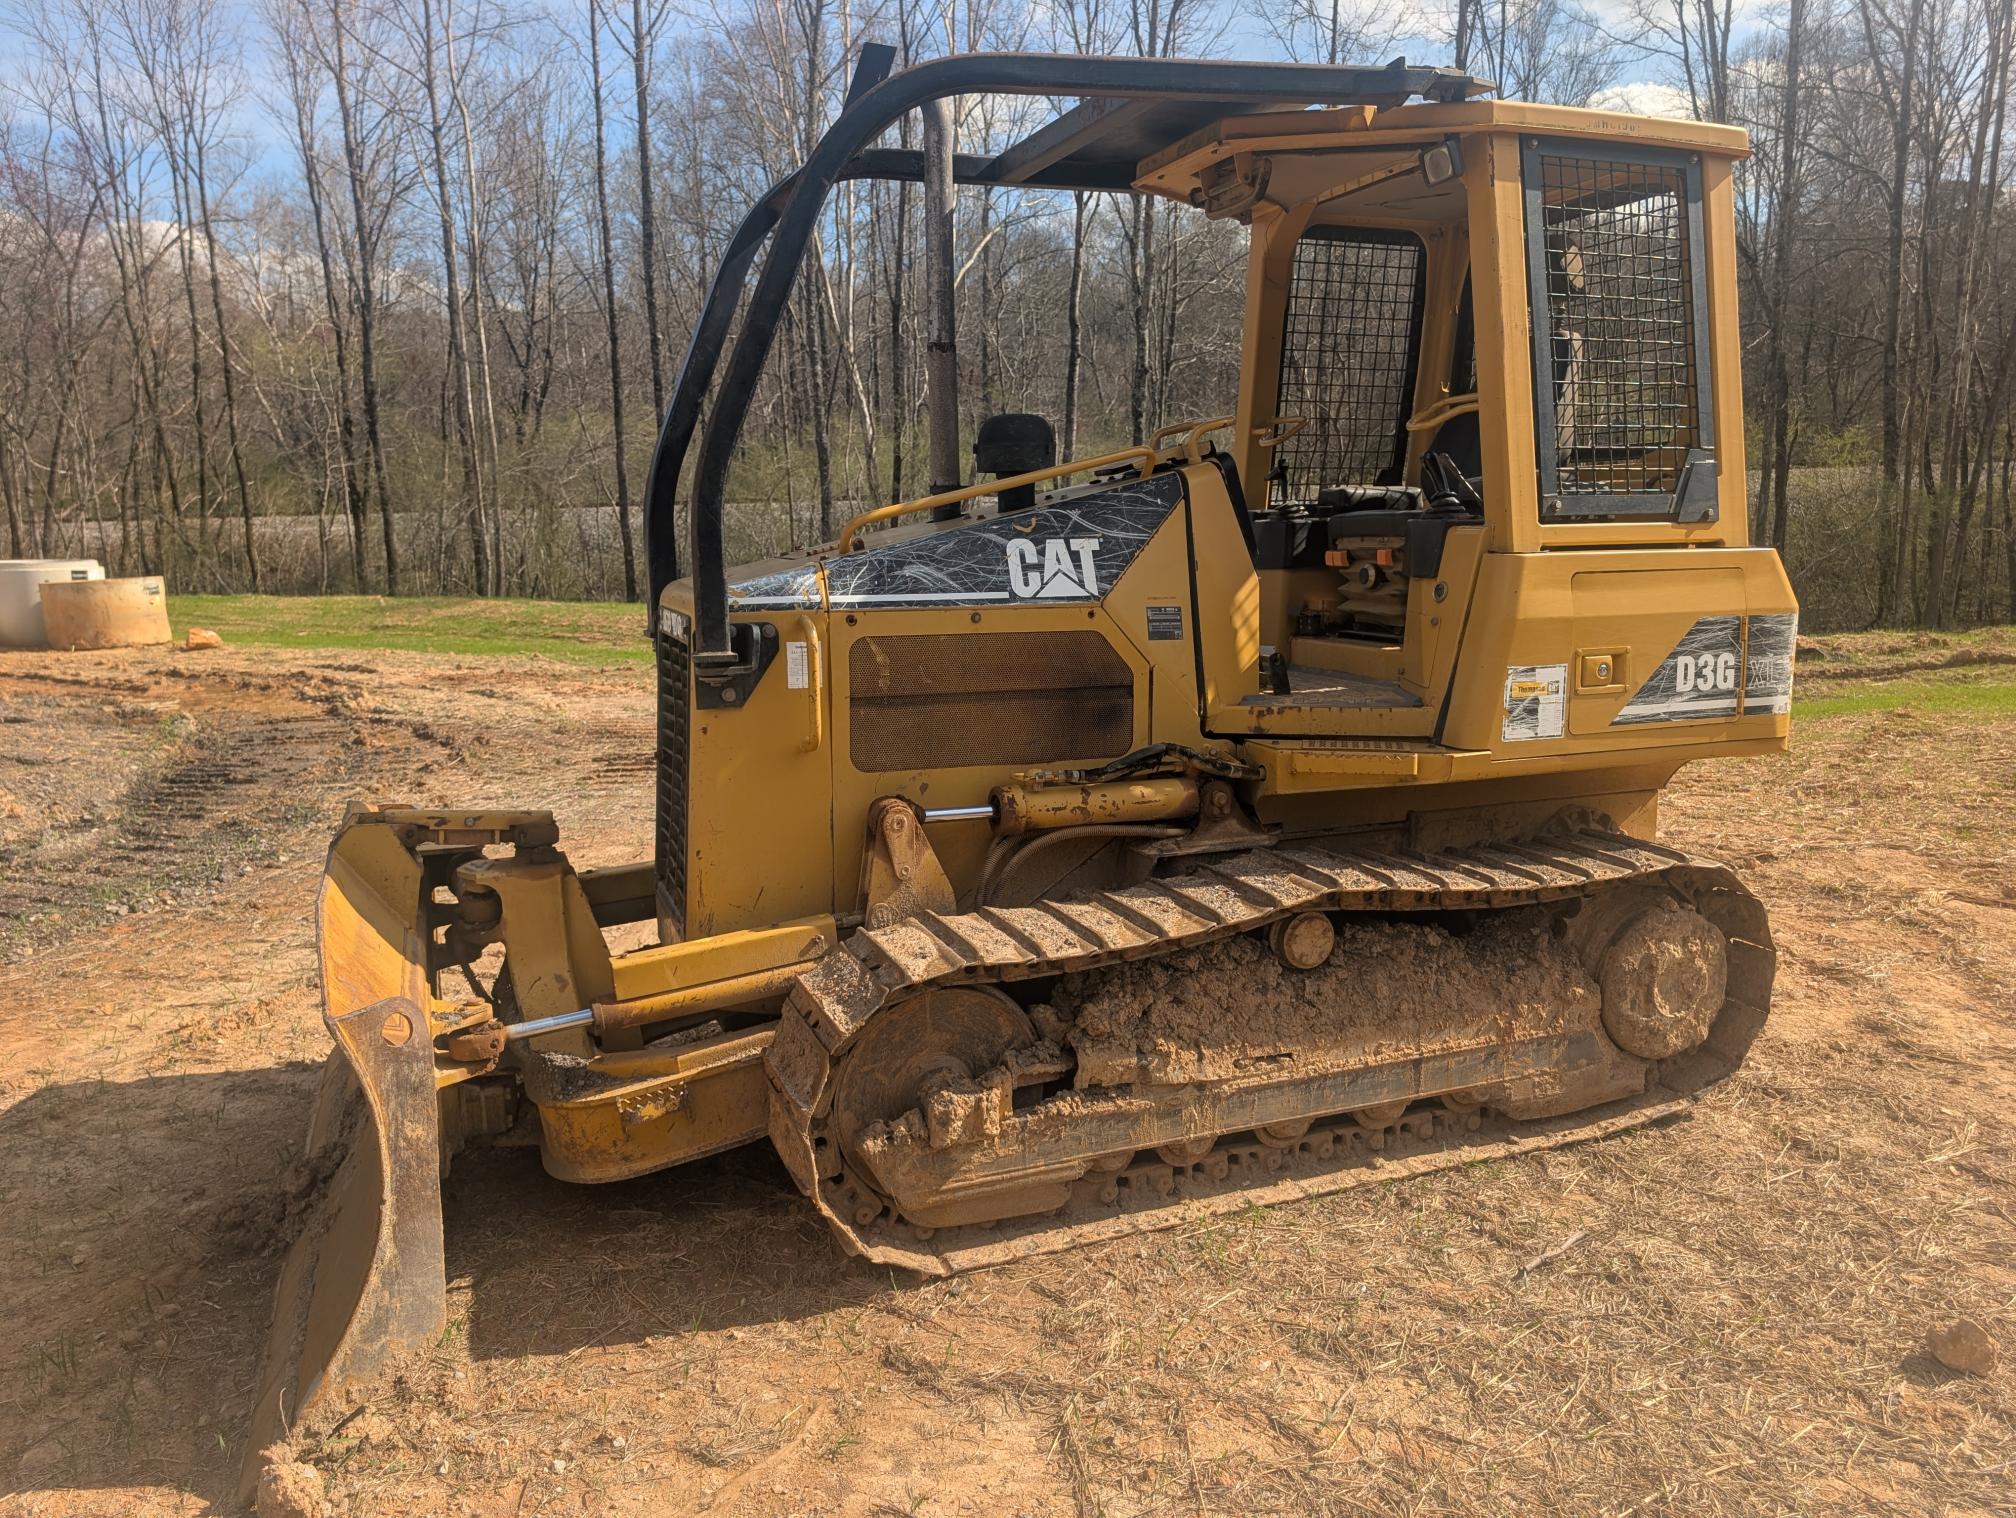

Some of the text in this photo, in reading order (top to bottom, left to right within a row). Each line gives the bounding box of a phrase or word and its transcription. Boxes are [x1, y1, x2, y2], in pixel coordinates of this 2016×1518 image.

[1006, 537, 1099, 598] CAT
[1676, 652, 1779, 692] D3G XL
